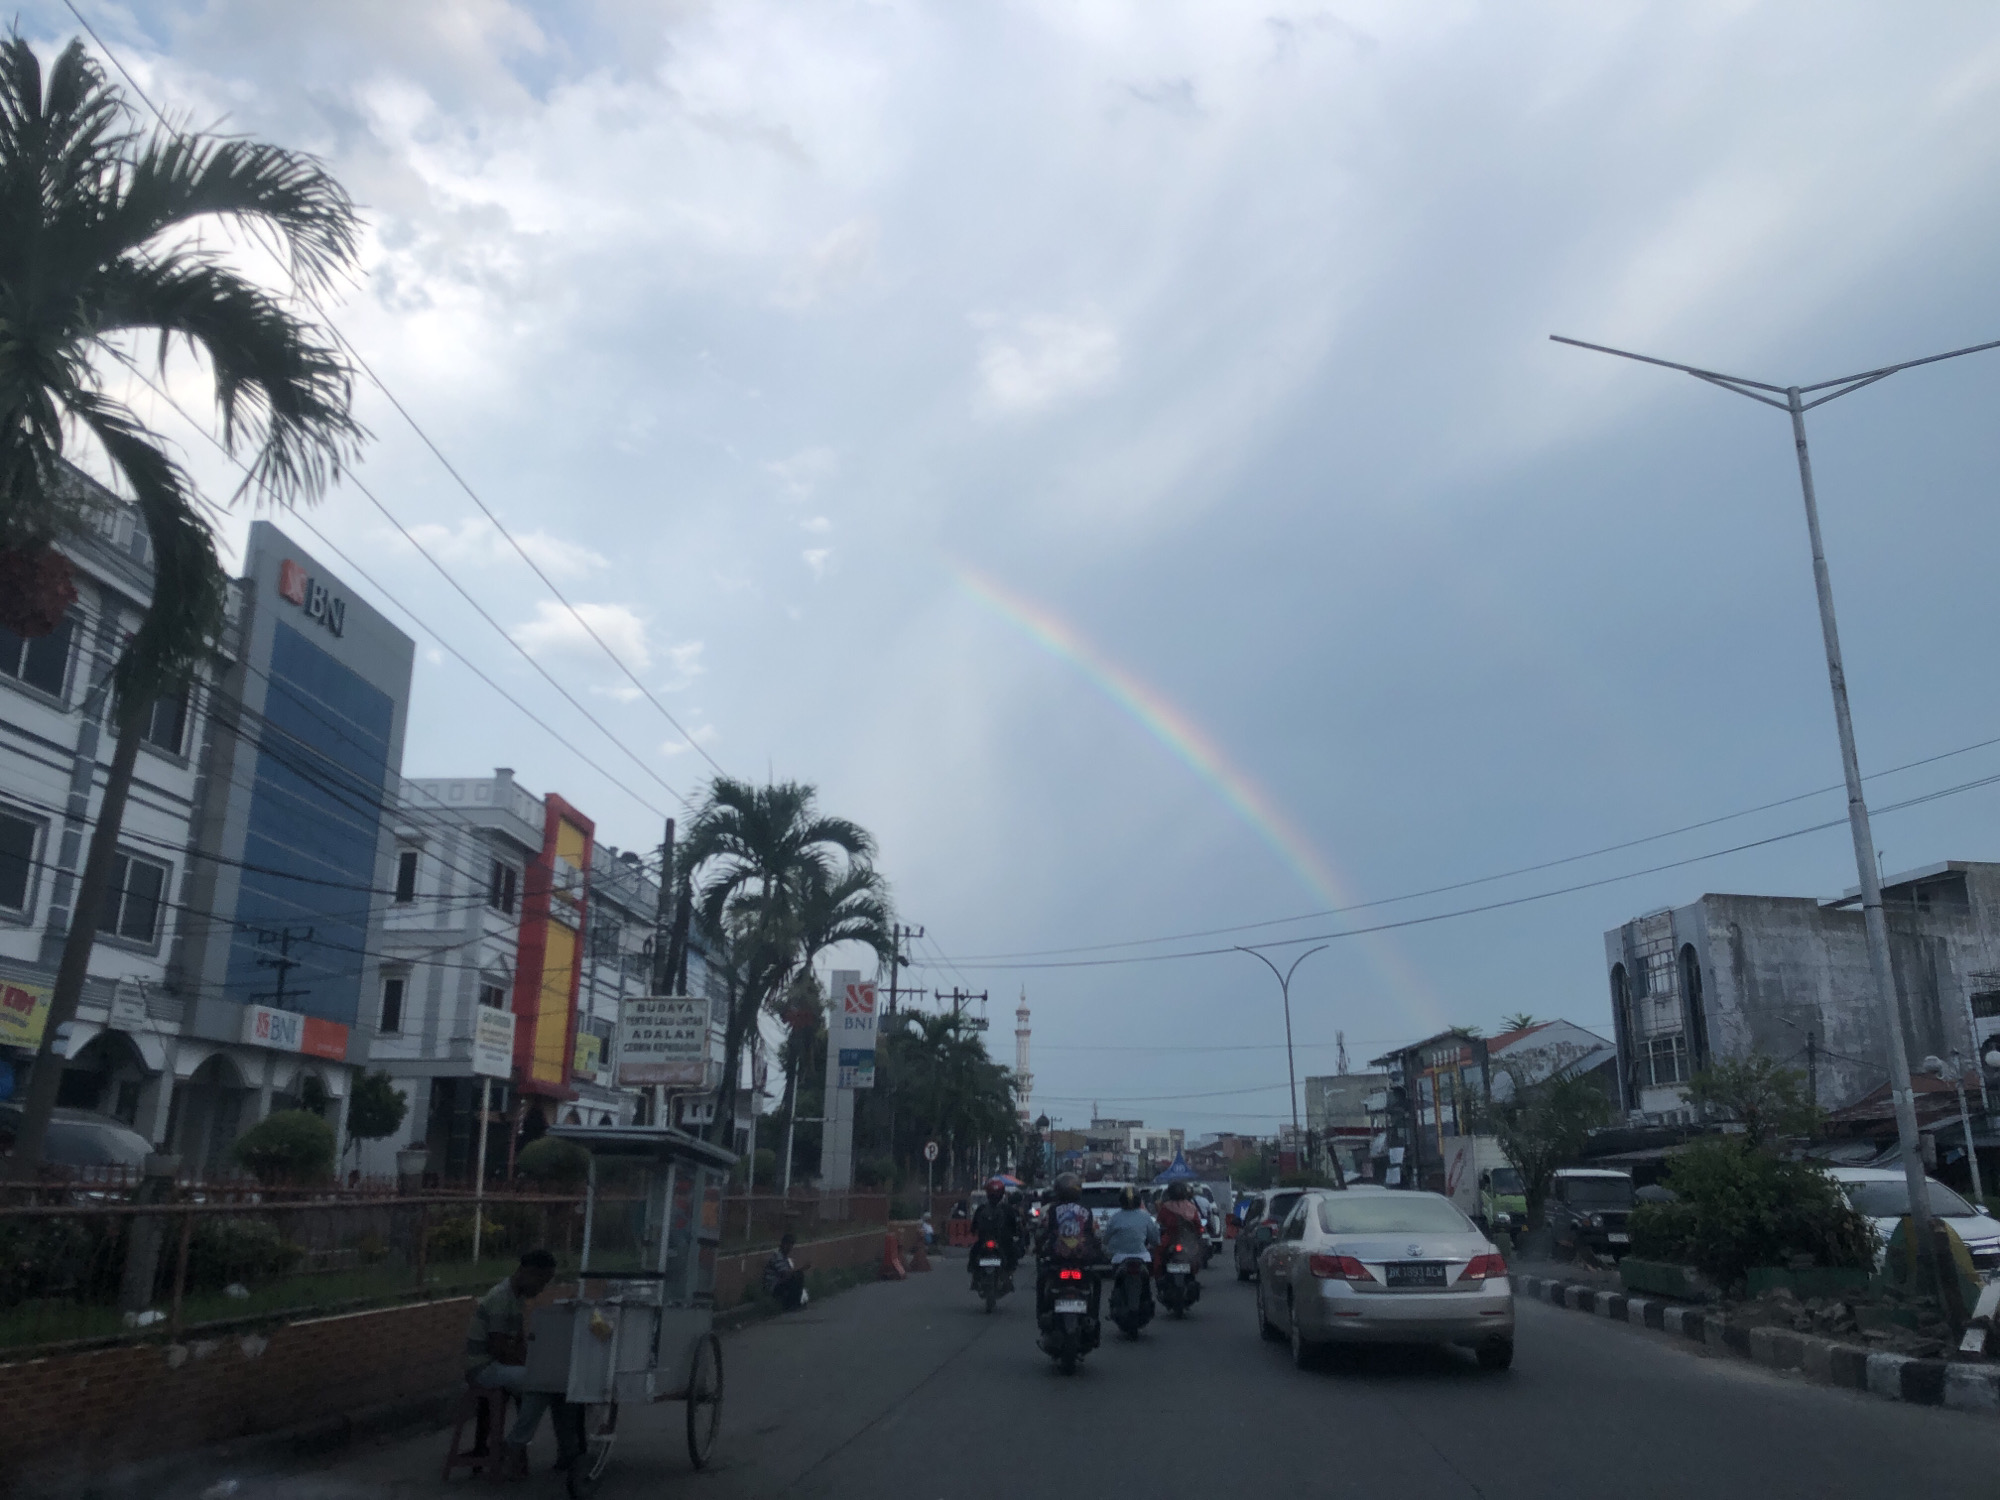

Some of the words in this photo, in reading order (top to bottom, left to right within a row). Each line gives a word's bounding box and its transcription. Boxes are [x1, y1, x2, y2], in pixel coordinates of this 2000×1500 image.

[304, 578, 346, 638] BNI
[637, 1003, 694, 1013] BUDAYA
[270, 1015, 297, 1044] BNI
[844, 1016, 873, 1031] BNI
[632, 1030, 695, 1039] ADALAH
